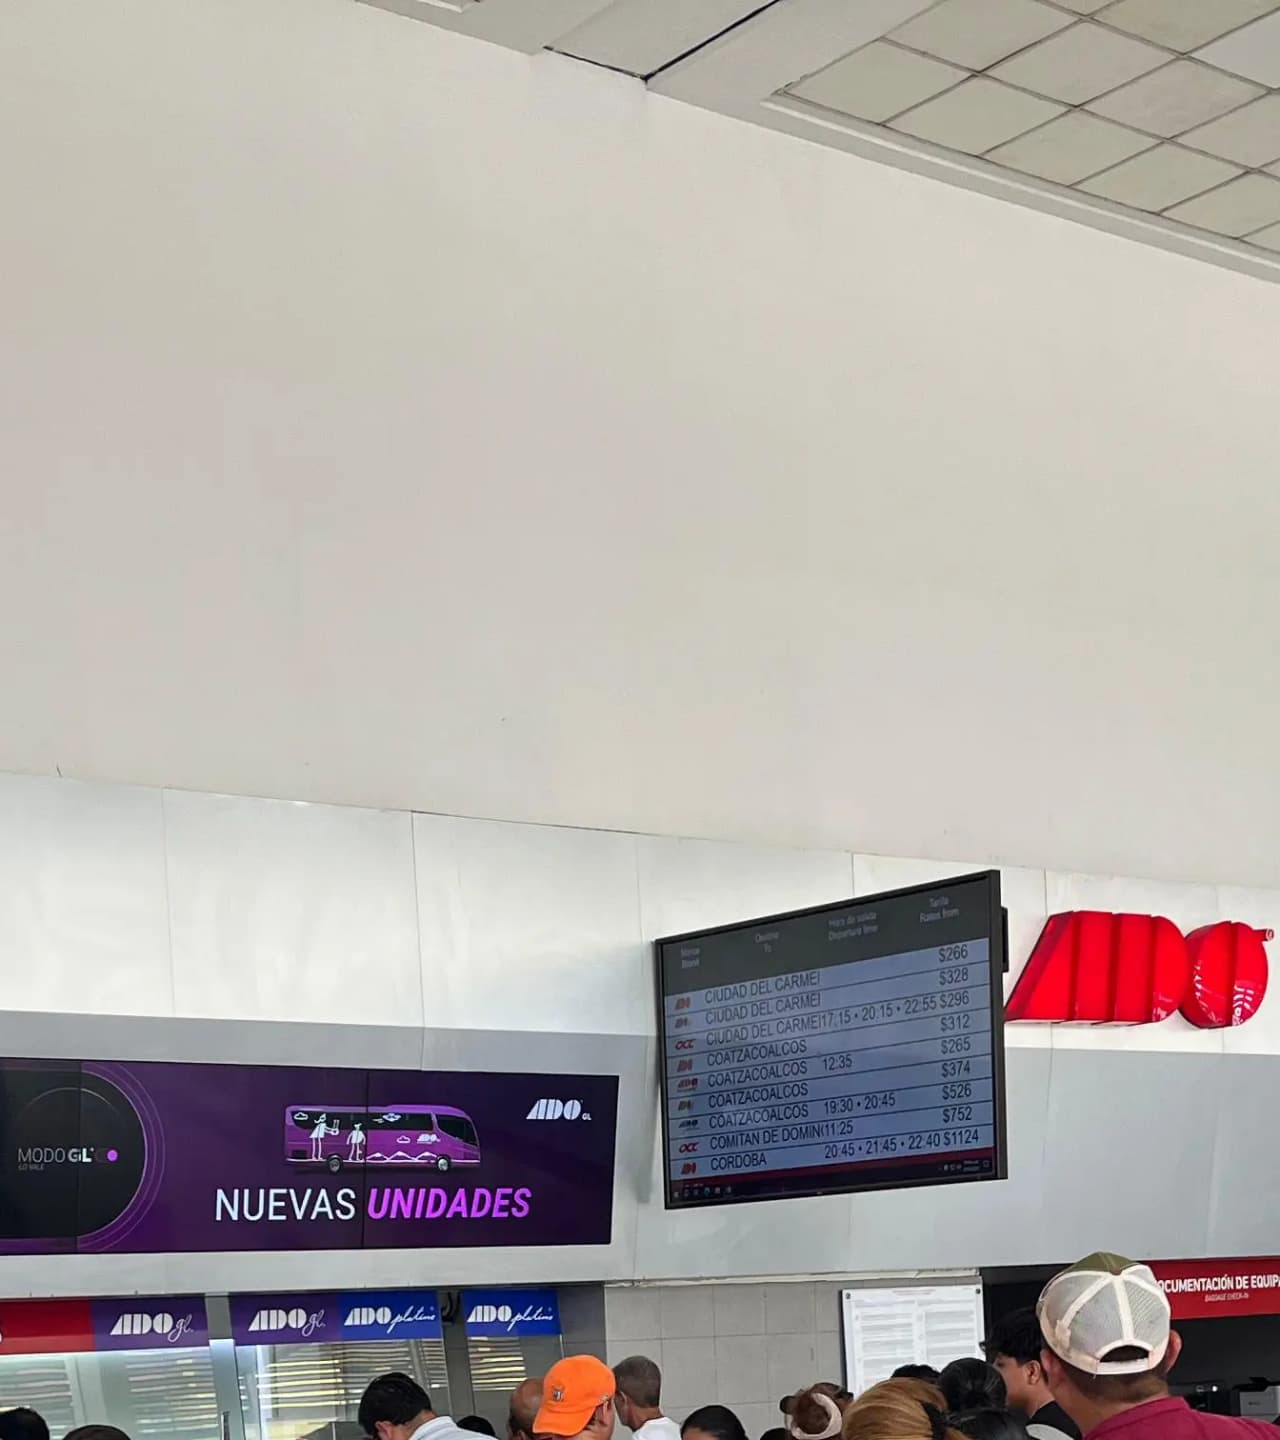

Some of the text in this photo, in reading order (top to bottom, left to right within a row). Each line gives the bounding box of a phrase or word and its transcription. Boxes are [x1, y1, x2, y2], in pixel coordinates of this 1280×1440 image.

[705, 985, 748, 1004] CIUDAD
[751, 981, 771, 996] DEL
[775, 971, 820, 991] CARME
[939, 944, 968, 963] $266
[1004, 911, 1268, 1029] ADO
[706, 1006, 748, 1024] CIUDAD
[751, 1002, 771, 1016] DEL
[776, 993, 820, 1012] CARME
[939, 967, 968, 985] $328
[706, 1027, 748, 1046] CIUDAD
[752, 1023, 772, 1038] DEL
[777, 1015, 821, 1034] CARME
[940, 991, 969, 1009] $296
[707, 1039, 807, 1066] COATZACOALCOS
[940, 1014, 970, 1032] $312
[708, 1060, 807, 1087] COATZACOALCOS
[823, 1054, 852, 1072] 12:35
[941, 1036, 970, 1055] $265
[709, 1082, 808, 1108] COATZACOALCOS
[942, 1060, 970, 1079] $374
[709, 1104, 809, 1129] COATZACOALCOS
[864, 1093, 896, 1110] 20:45
[942, 1083, 971, 1100] $526
[526, 1099, 582, 1120] ADO
[710, 1131, 760, 1150] COMITAN
[763, 1129, 779, 1144] DE
[943, 1106, 972, 1123] $752
[17, 1147, 66, 1163] MODO
[711, 1153, 767, 1171] CORDOBA
[944, 1129, 978, 1146] $1124
[214, 1187, 532, 1221] NUEVAS UNIDADES
[1154, 1273, 1235, 1294] OCUMENTACIÓN
[1235, 1277, 1249, 1290] DE
